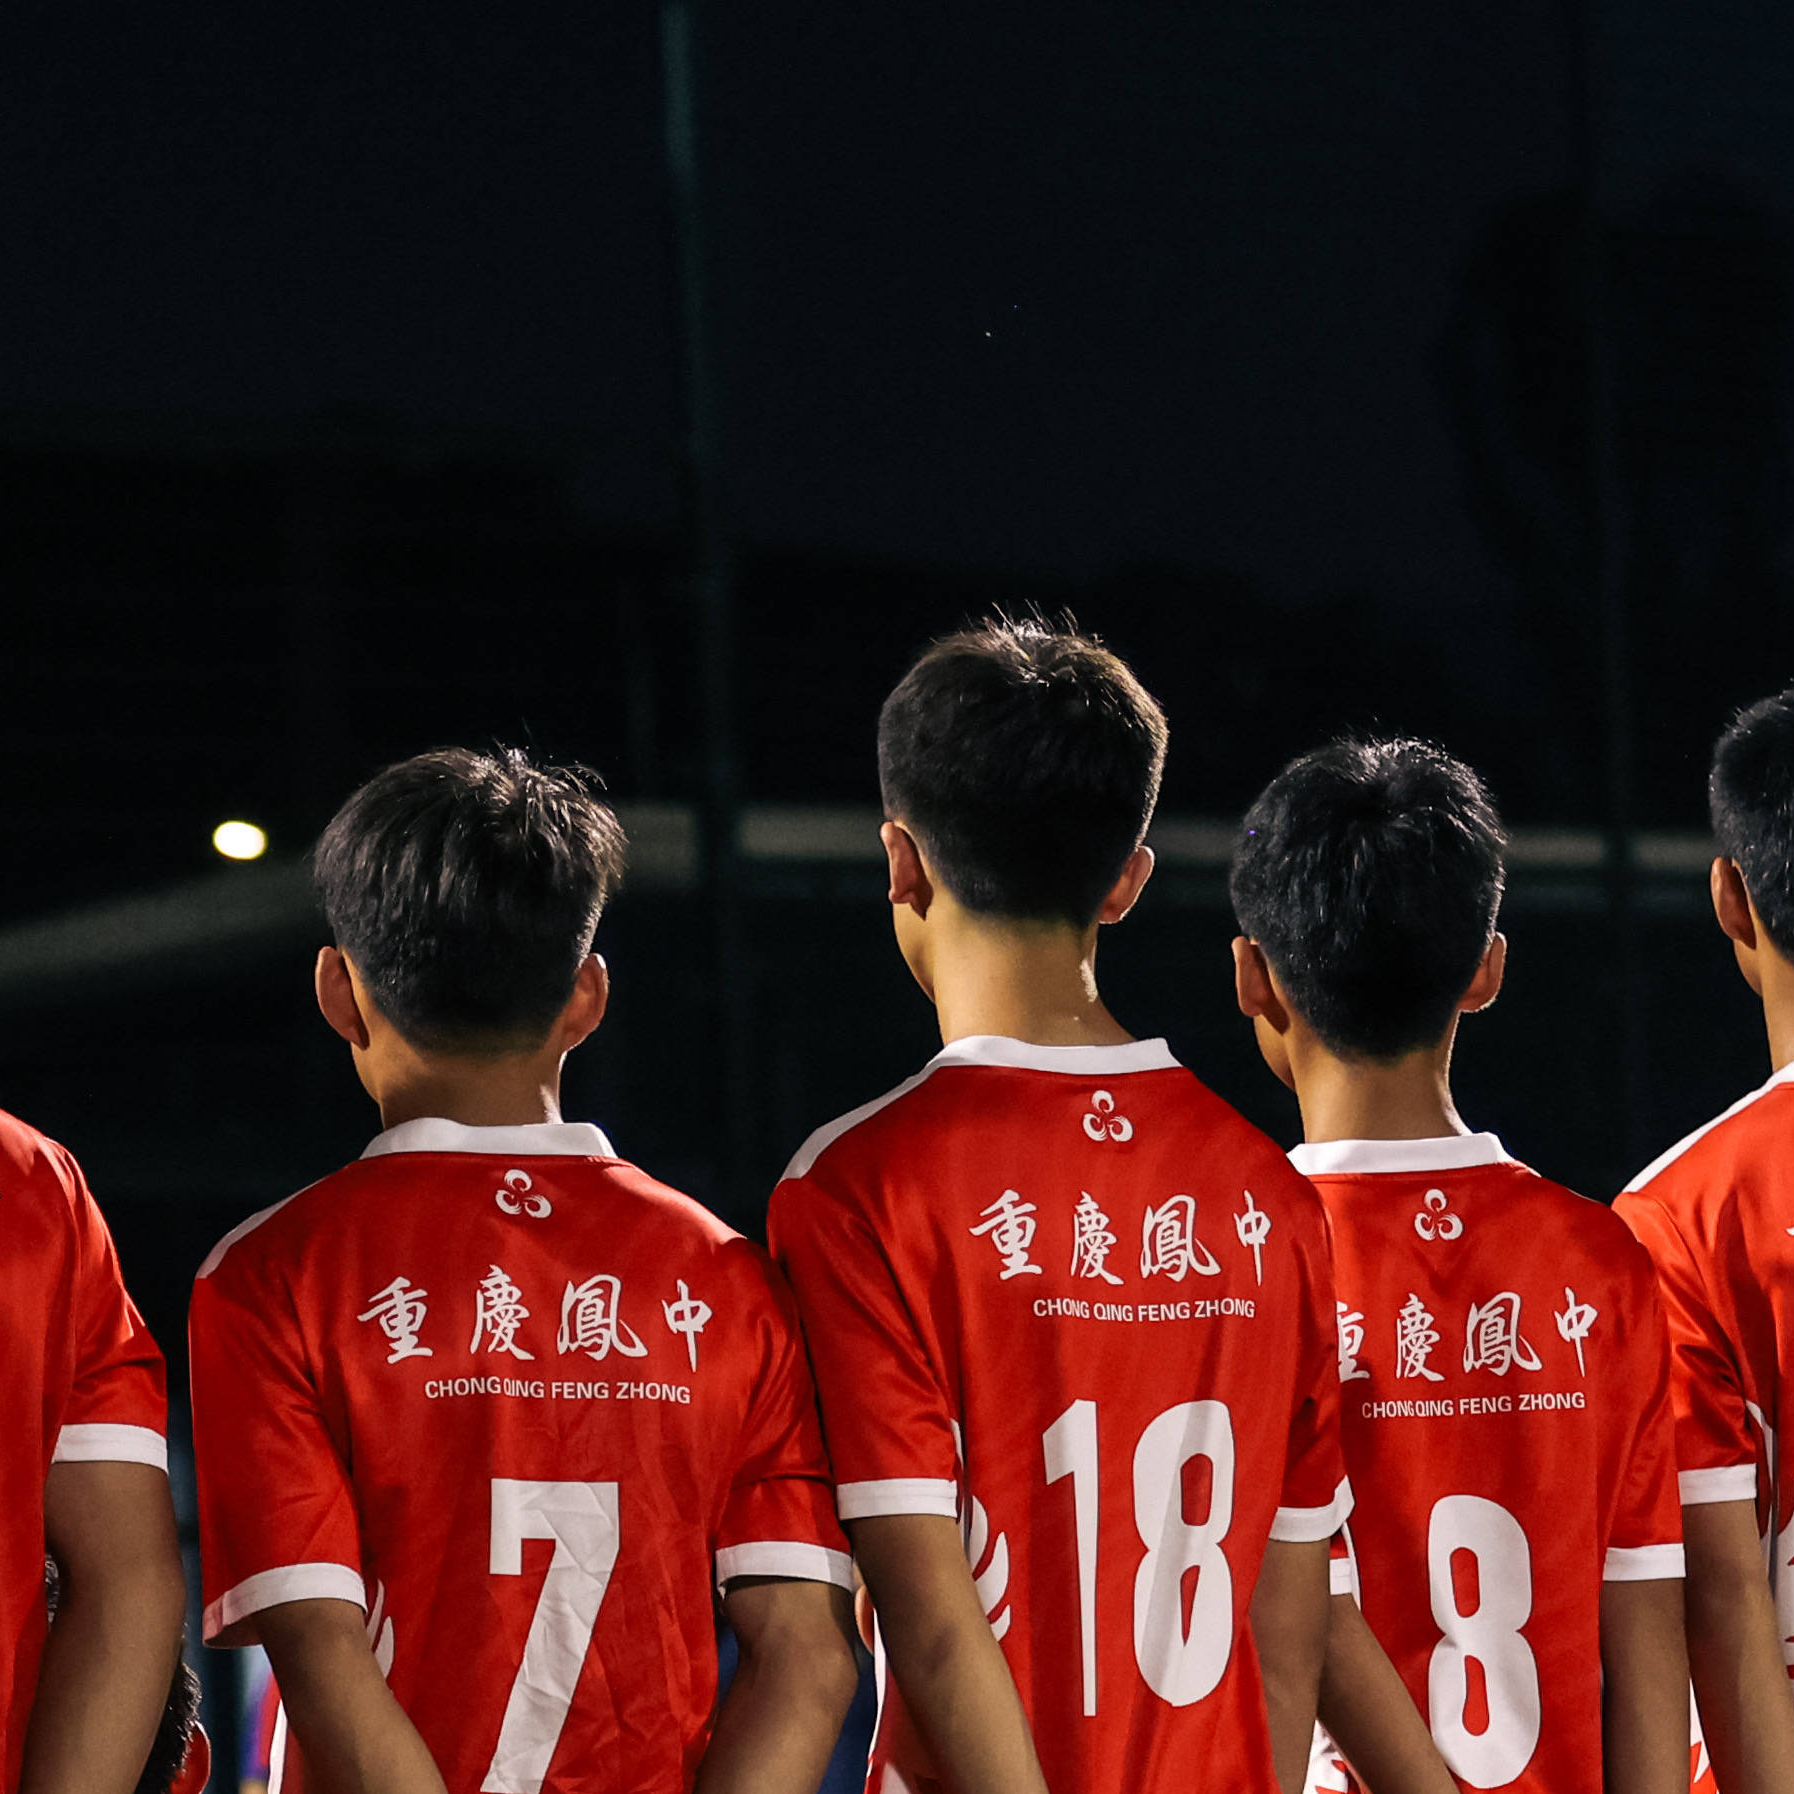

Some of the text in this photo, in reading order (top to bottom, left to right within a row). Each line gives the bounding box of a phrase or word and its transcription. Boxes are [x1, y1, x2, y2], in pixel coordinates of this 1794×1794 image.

[969, 1190, 1271, 1285] 重慶鳳中
[357, 1265, 712, 1372] 重慶鳳中
[1033, 1298, 1255, 1322] CHONG QING FENG ZHONG
[424, 1377, 691, 1404] CHONG QING FENG ZHONG
[1361, 1391, 1586, 1419] CHONG QING FENG ZHONG
[1043, 1399, 1234, 1716] 18
[480, 1478, 619, 1794] 7
[1428, 1495, 1540, 1789] 8
